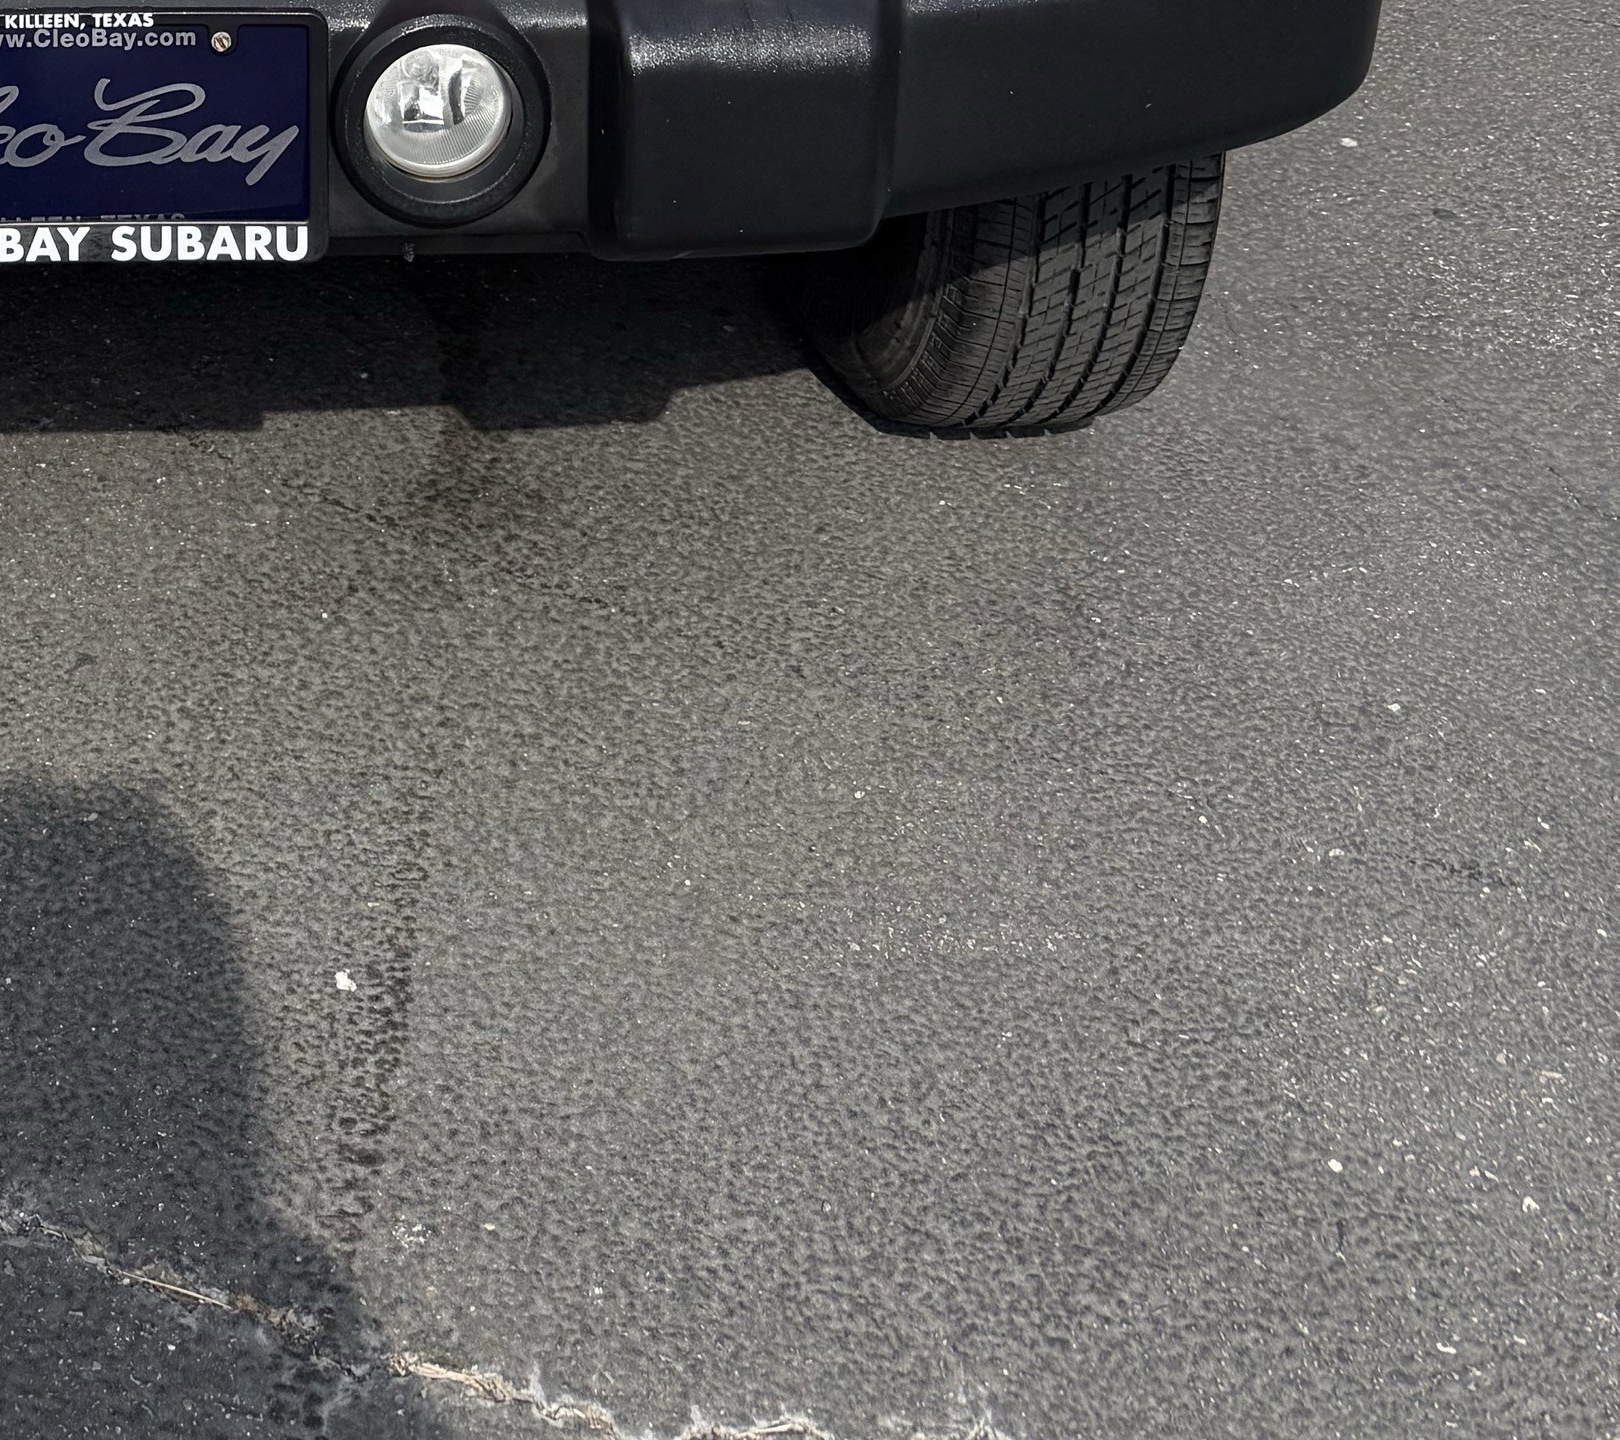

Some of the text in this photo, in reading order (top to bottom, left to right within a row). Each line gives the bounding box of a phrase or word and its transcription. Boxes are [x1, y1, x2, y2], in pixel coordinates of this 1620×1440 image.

[4, 12, 155, 30] KILLEEN, TEXAS
[83, 78, 300, 186] Bay
[110, 225, 309, 263] SUBARU
